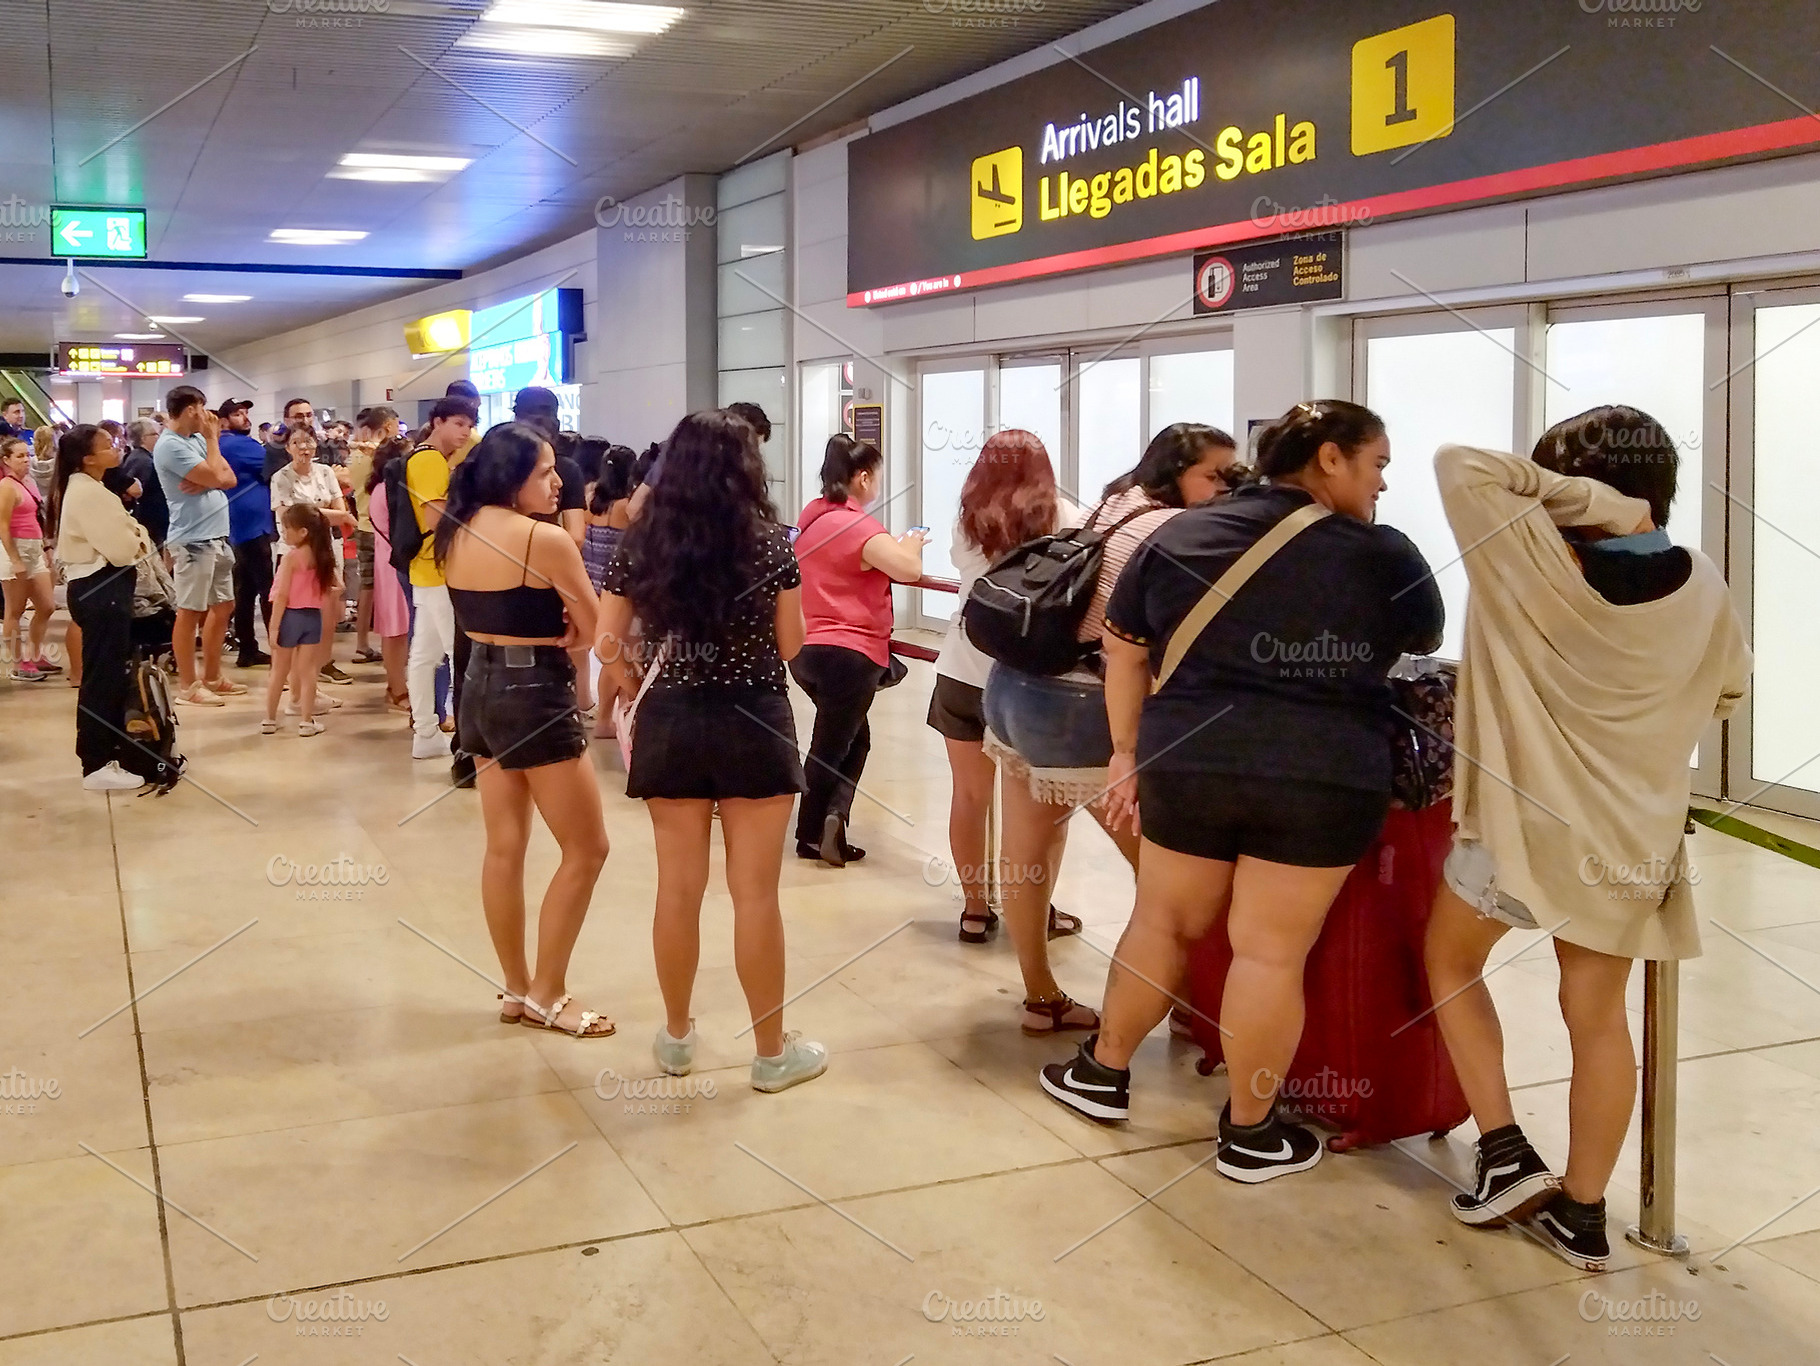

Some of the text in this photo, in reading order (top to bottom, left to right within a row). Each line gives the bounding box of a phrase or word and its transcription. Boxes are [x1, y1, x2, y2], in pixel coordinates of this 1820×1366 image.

[1385, 50, 1417, 126] 1
[1041, 76, 1199, 164] Arrivals hall
[1039, 113, 1316, 221] Llegadas Sala
[1242, 258, 1281, 272] Authorized
[1293, 252, 1327, 265] Zona de
[1242, 272, 1268, 283] Access
[1293, 265, 1323, 276] Acceso
[1293, 271, 1339, 287] Controlado
[1242, 283, 1259, 293] Area
